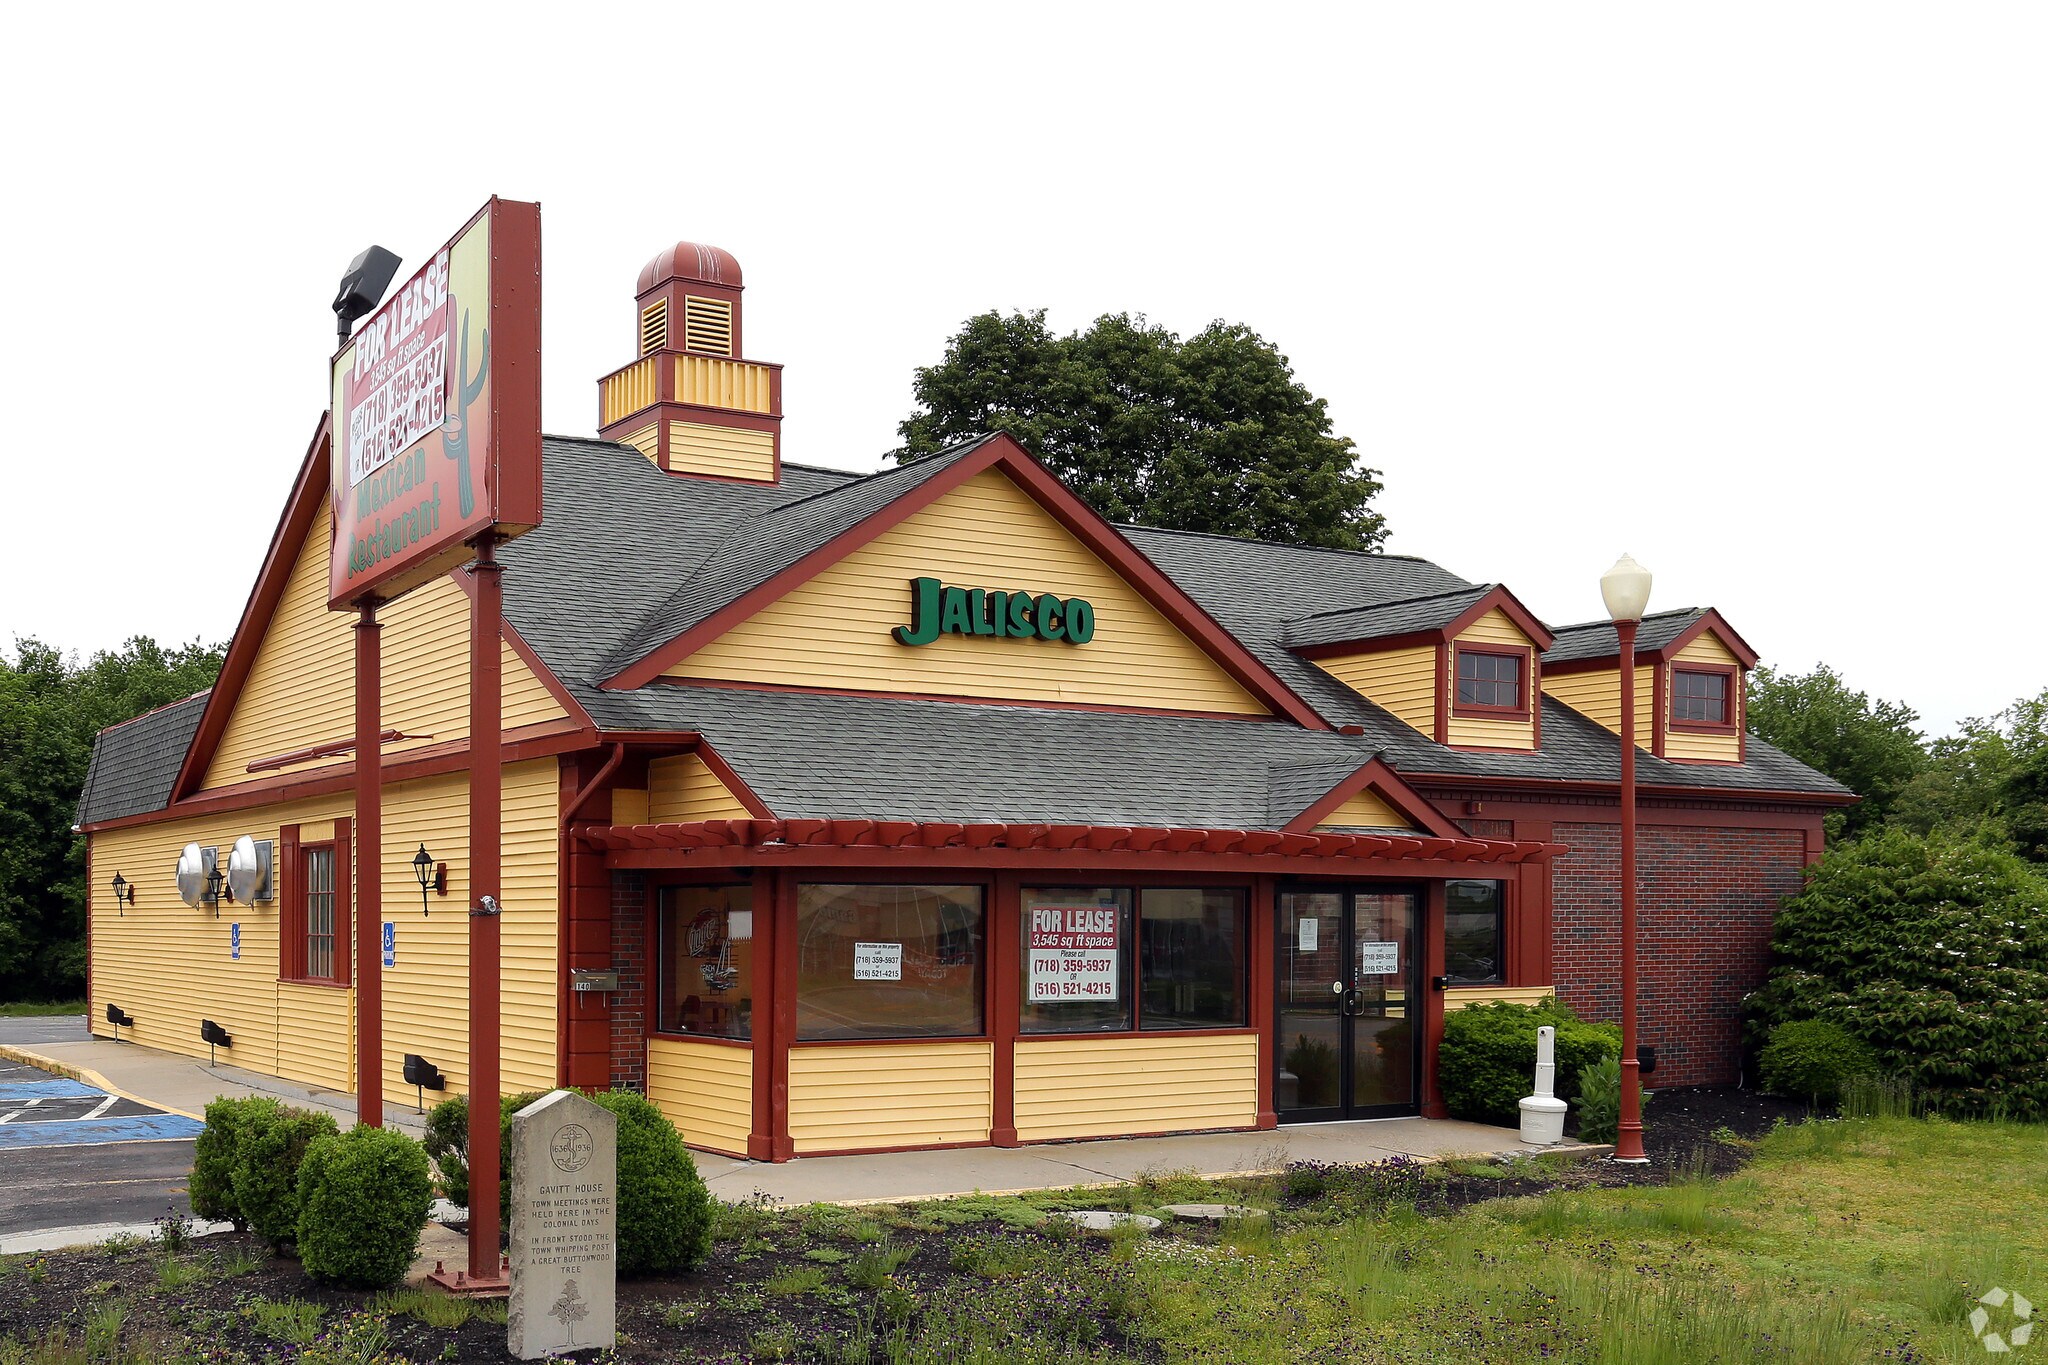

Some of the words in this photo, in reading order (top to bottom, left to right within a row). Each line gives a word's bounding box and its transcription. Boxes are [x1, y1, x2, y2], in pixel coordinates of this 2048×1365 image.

[354, 313, 387, 382] FOR
[390, 249, 448, 351] LEASE
[404, 330, 426, 363] space
[362, 386, 387, 436] (718)
[362, 428, 386, 474] (516)
[388, 384, 443, 453] 521-4215
[357, 448, 425, 523] Mexican
[348, 482, 440, 579] Restaurant
[890, 577, 1095, 646] JALISCO
[1032, 910, 1062, 932] FOR
[1066, 910, 1114, 933] LEASE
[1032, 934, 1059, 948] 3,545
[1060, 936, 1073, 948] sq
[1076, 934, 1084, 946] ft
[1086, 936, 1114, 949] space
[1060, 950, 1077, 958] Please
[1078, 950, 1086, 958] call
[856, 970, 871, 978] (516)
[1034, 959, 1060, 974] (718)
[1063, 960, 1111, 972] 359-5937
[1034, 982, 1060, 998] (516)
[1063, 982, 1111, 995] 521-4215
[552, 1145, 567, 1153] 1636
[576, 1144, 590, 1152] 1936
[540, 1185, 570, 1194] GAVITT
[576, 1184, 603, 1193] HOUSE
[554, 1199, 588, 1207] MEETINGS
[543, 1236, 566, 1244] FRONT
[555, 1245, 588, 1253] WHIPPING
[539, 1257, 561, 1265] GREAT
[564, 1254, 610, 1263] BUTTONWOOD
[561, 1266, 581, 1274] TREE
